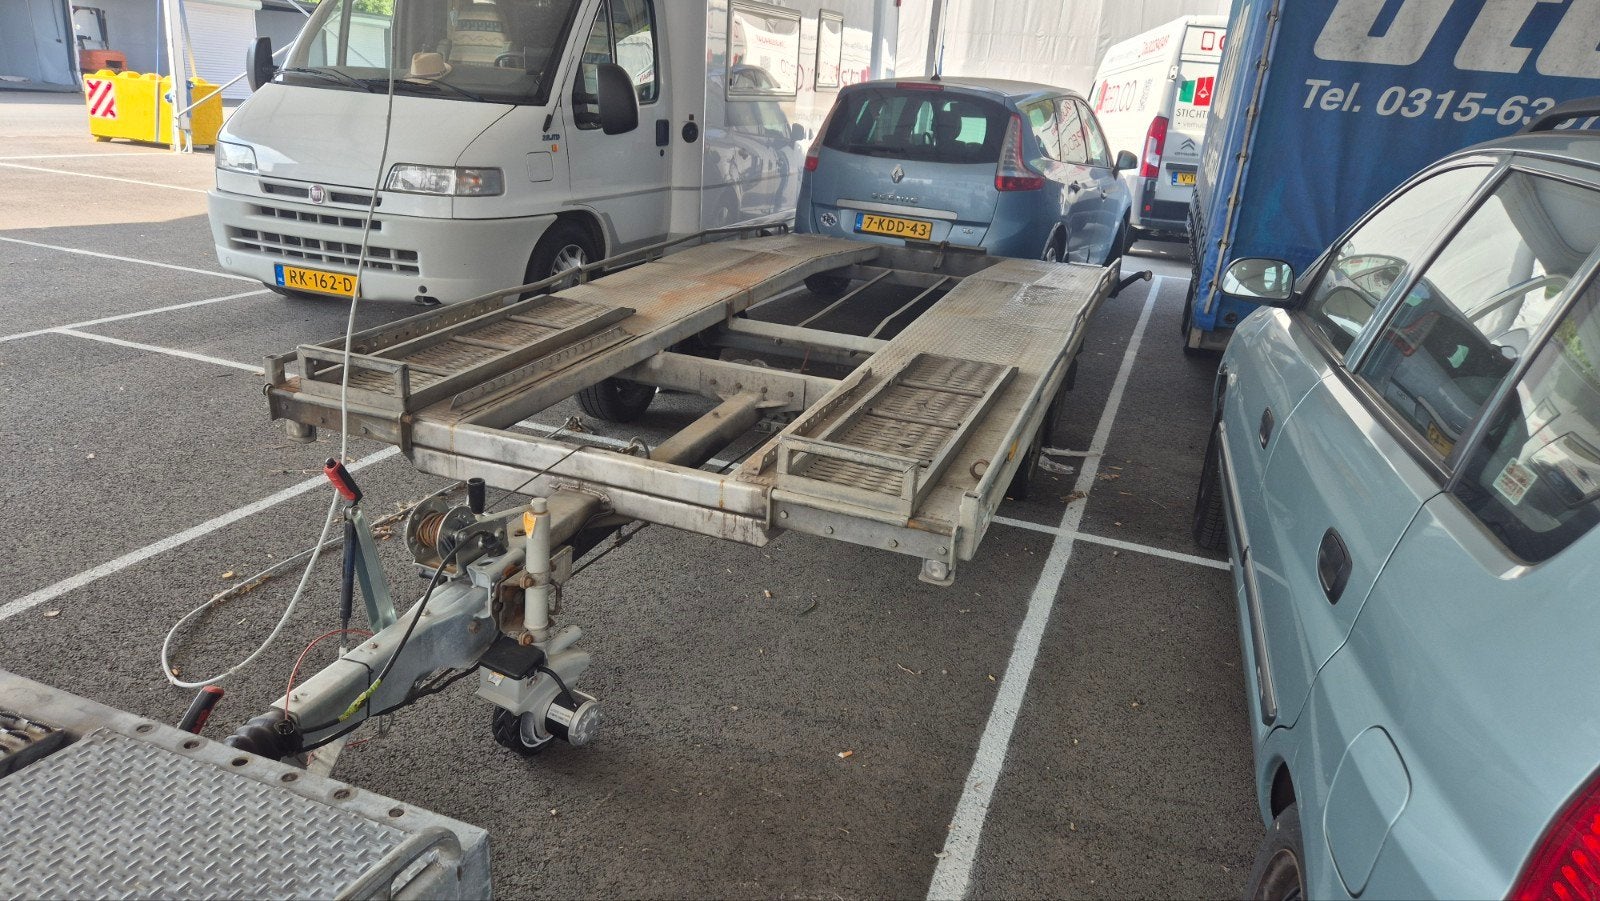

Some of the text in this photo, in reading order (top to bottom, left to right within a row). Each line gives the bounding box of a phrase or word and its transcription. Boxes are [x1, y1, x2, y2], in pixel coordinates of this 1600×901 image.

[1176, 108, 1209, 120] STICHT
[1303, 78, 1600, 130] Tel. 0315-63
[1181, 174, 1196, 183] V-1
[866, 216, 927, 237] 7-KDD-43
[289, 269, 352, 292] RK-162-D
